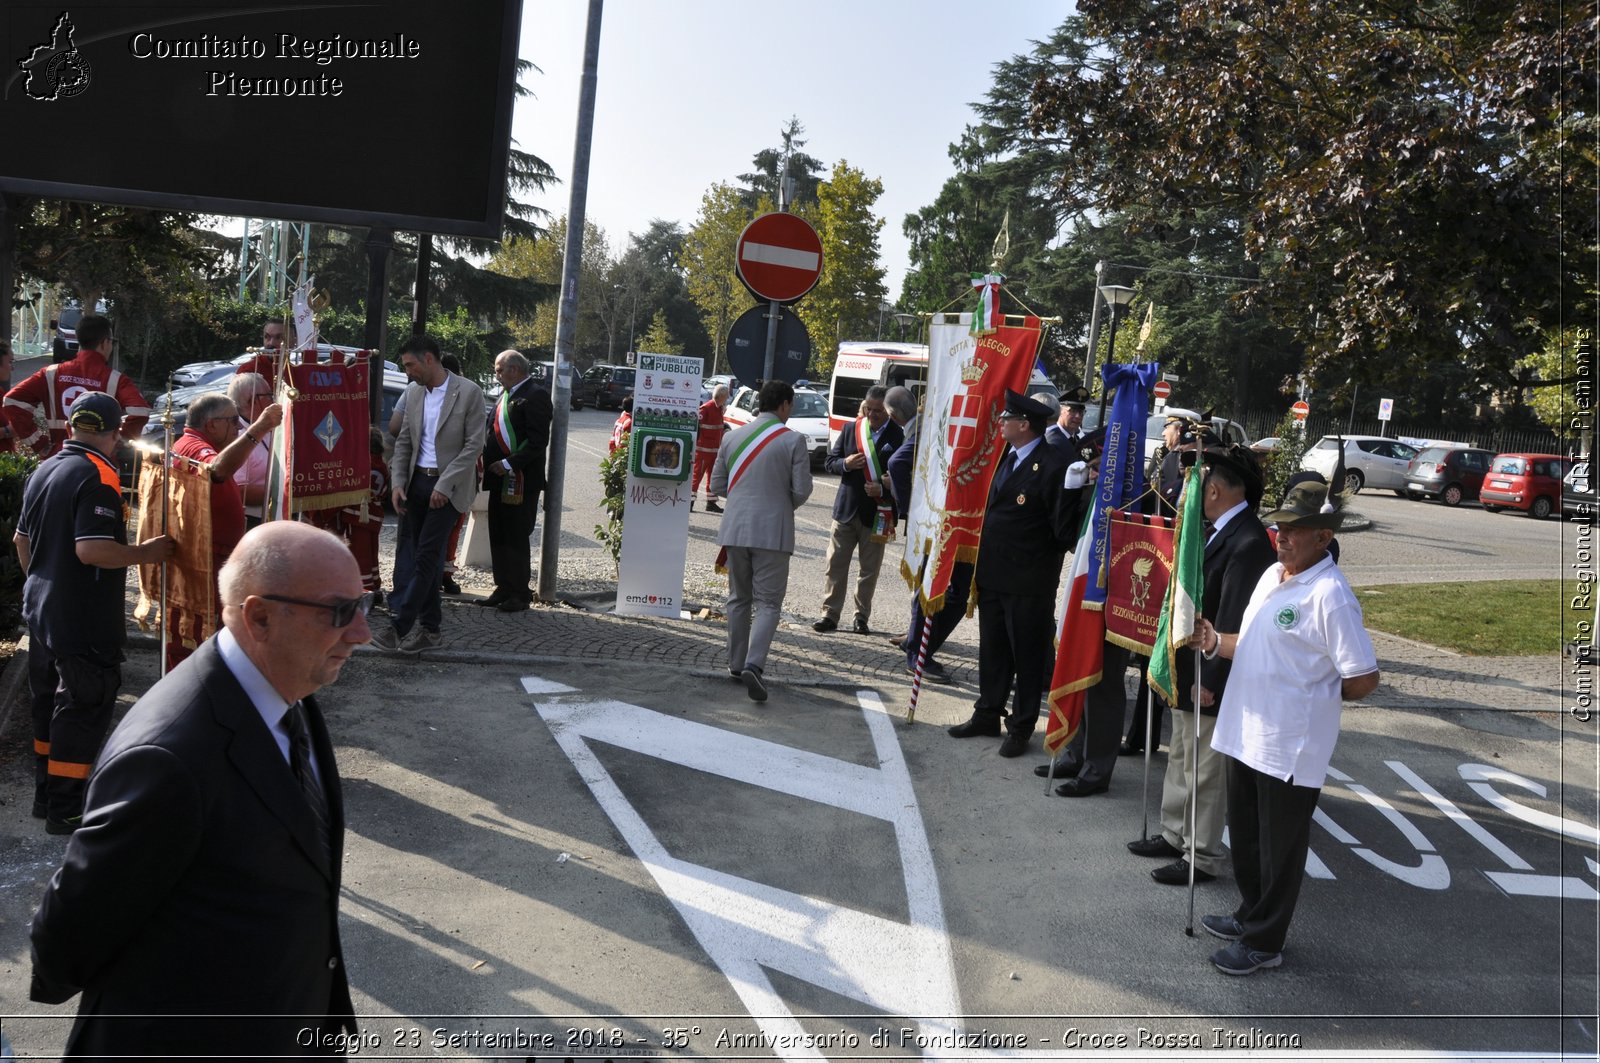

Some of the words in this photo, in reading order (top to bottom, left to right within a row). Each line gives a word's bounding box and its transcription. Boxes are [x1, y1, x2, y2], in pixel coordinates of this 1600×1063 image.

[978, 338, 1011, 357] OLEGGIO
[655, 356, 701, 366] DEFIBRILLATORE
[845, 361, 872, 370] SOCCORSO
[655, 362, 701, 375] PUBBLICO
[1102, 422, 1122, 502] CARABINIERI
[1123, 431, 1138, 493] OLEGGIO
[295, 467, 354, 482] OLEGGIO
[625, 595, 648, 604] emd
[658, 597, 673, 606] 112
